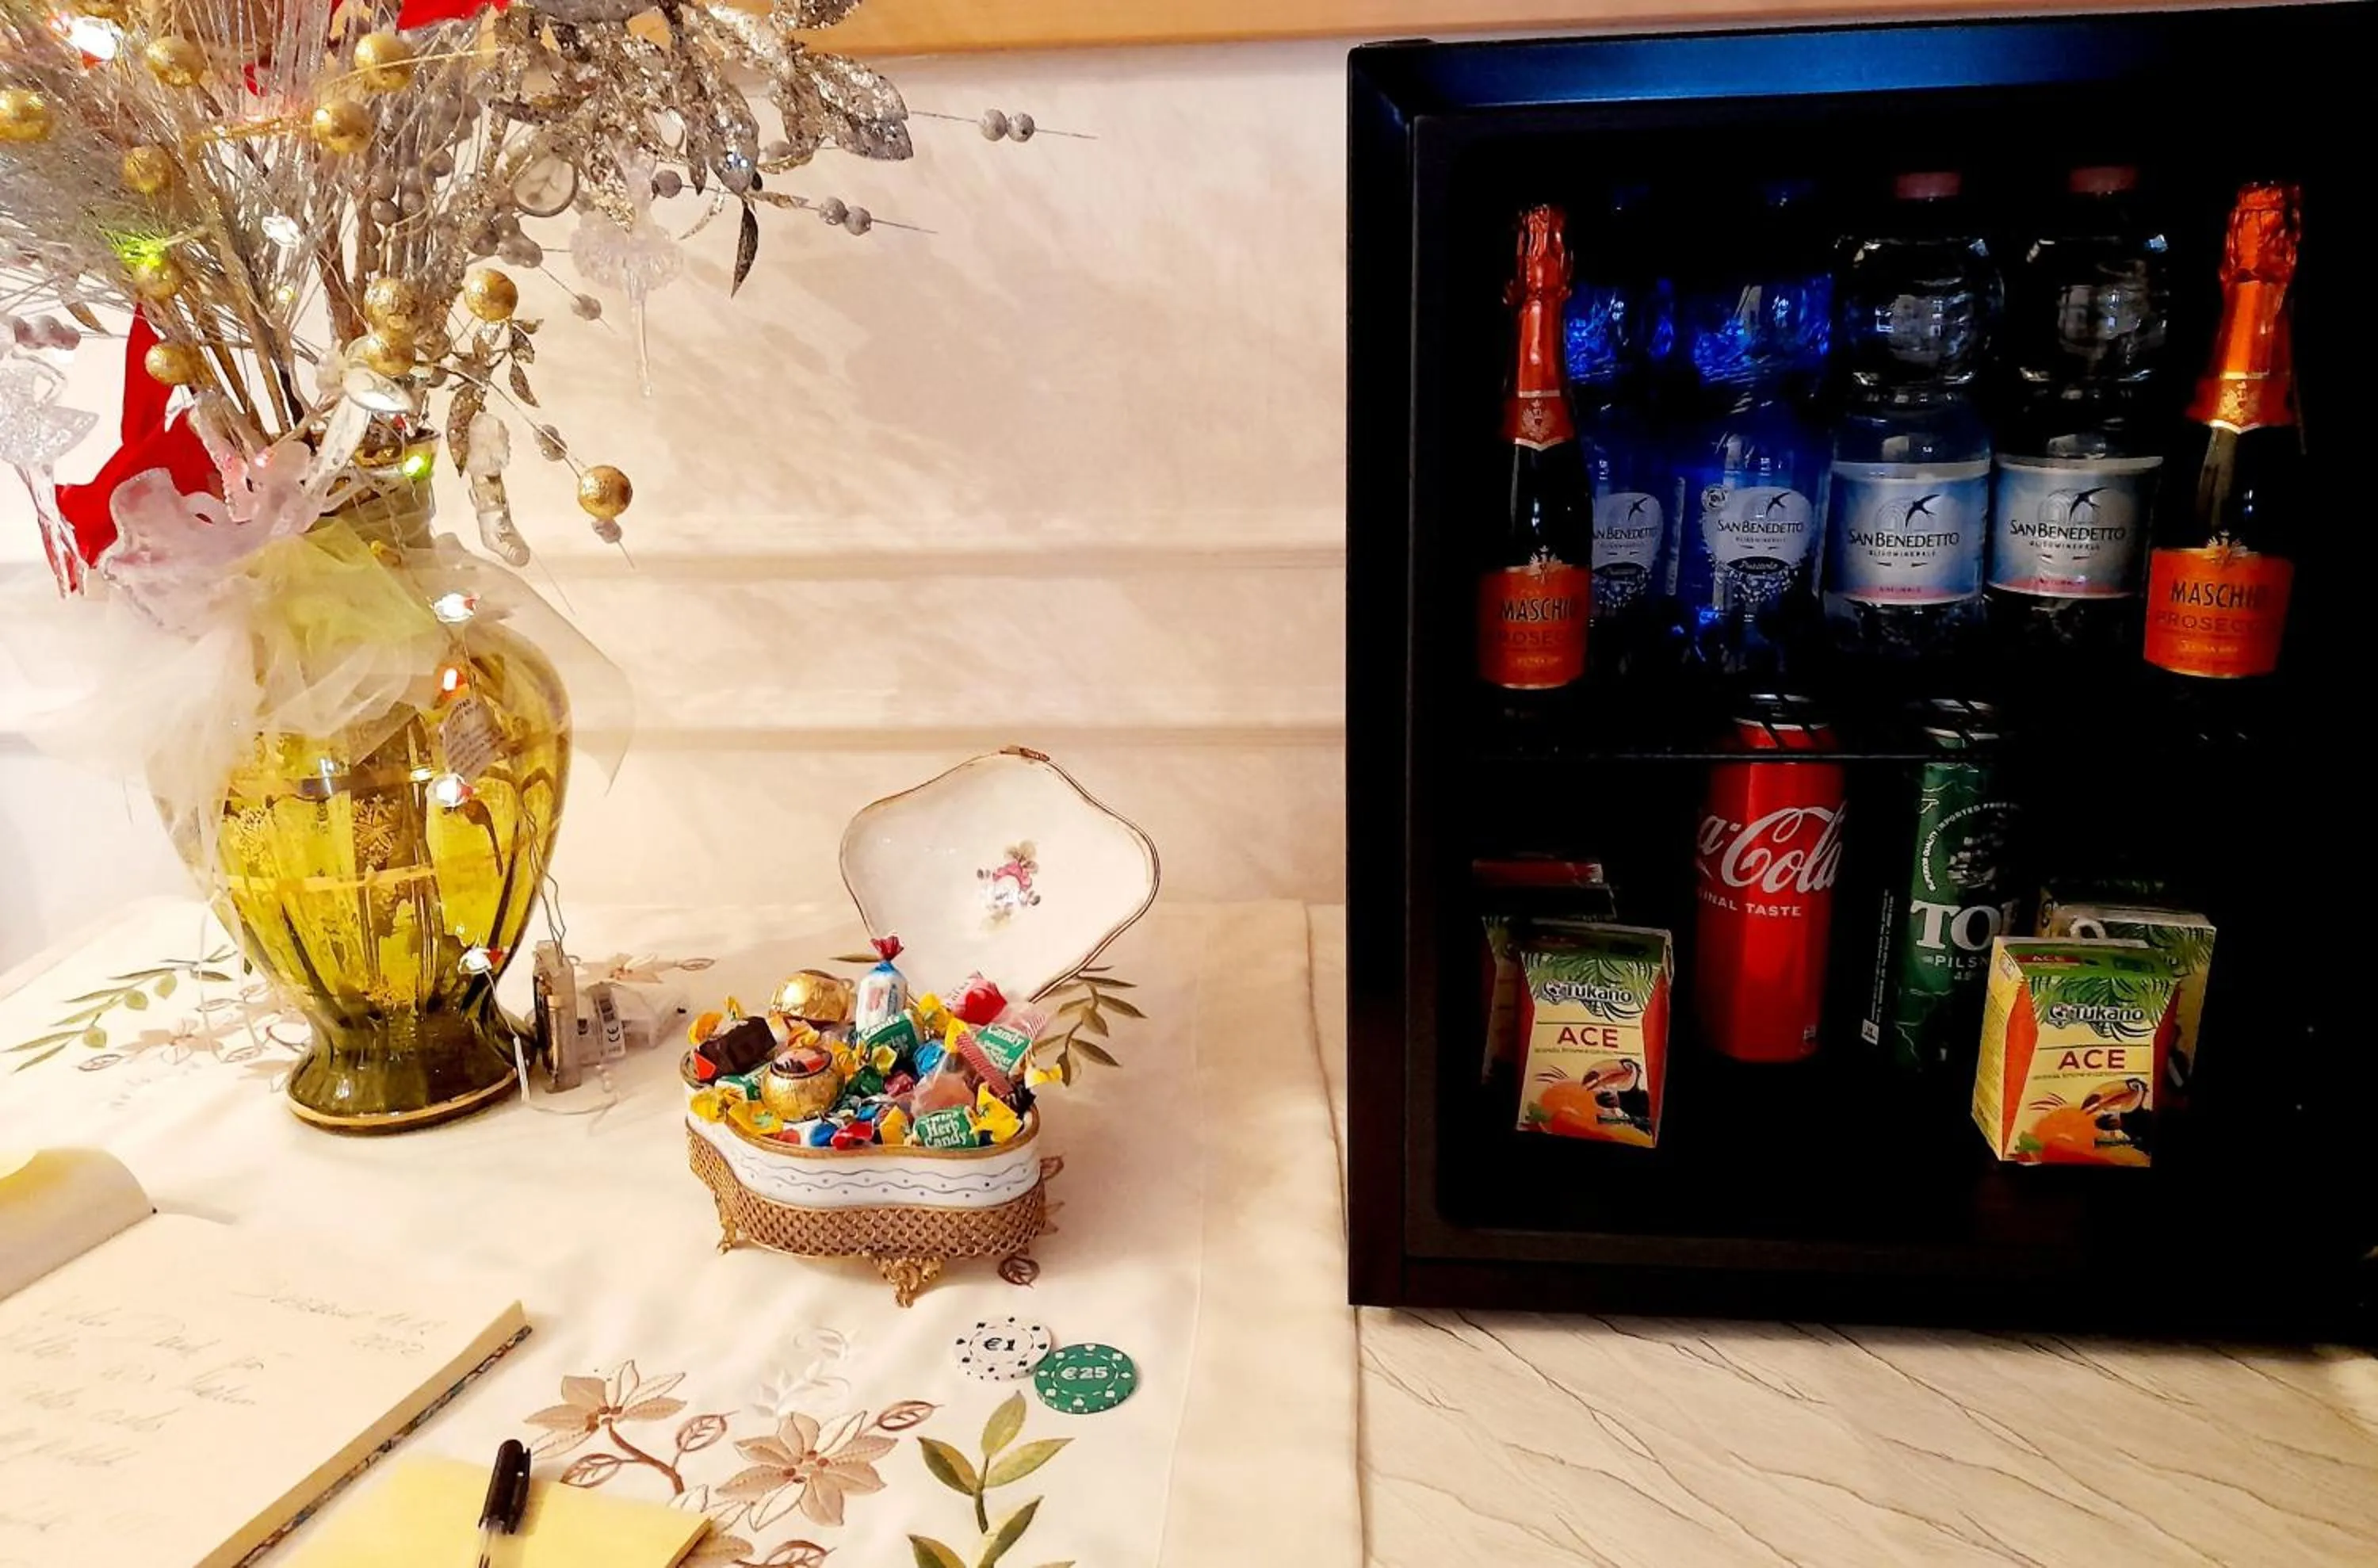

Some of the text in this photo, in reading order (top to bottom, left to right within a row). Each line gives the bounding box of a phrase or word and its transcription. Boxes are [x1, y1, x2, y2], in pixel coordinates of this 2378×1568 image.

[1745, 902, 1802, 917] TASTE
[2074, 1005, 2145, 1023] Tukano
[987, 1025, 1026, 1048] Candy
[1557, 1027, 1619, 1049] ACE
[2058, 1049, 2126, 1070] ACE
[926, 1118, 960, 1138] Herb
[924, 1130, 967, 1149] Candy
[983, 1337, 1015, 1352] €1
[1060, 1366, 1108, 1380] €25
